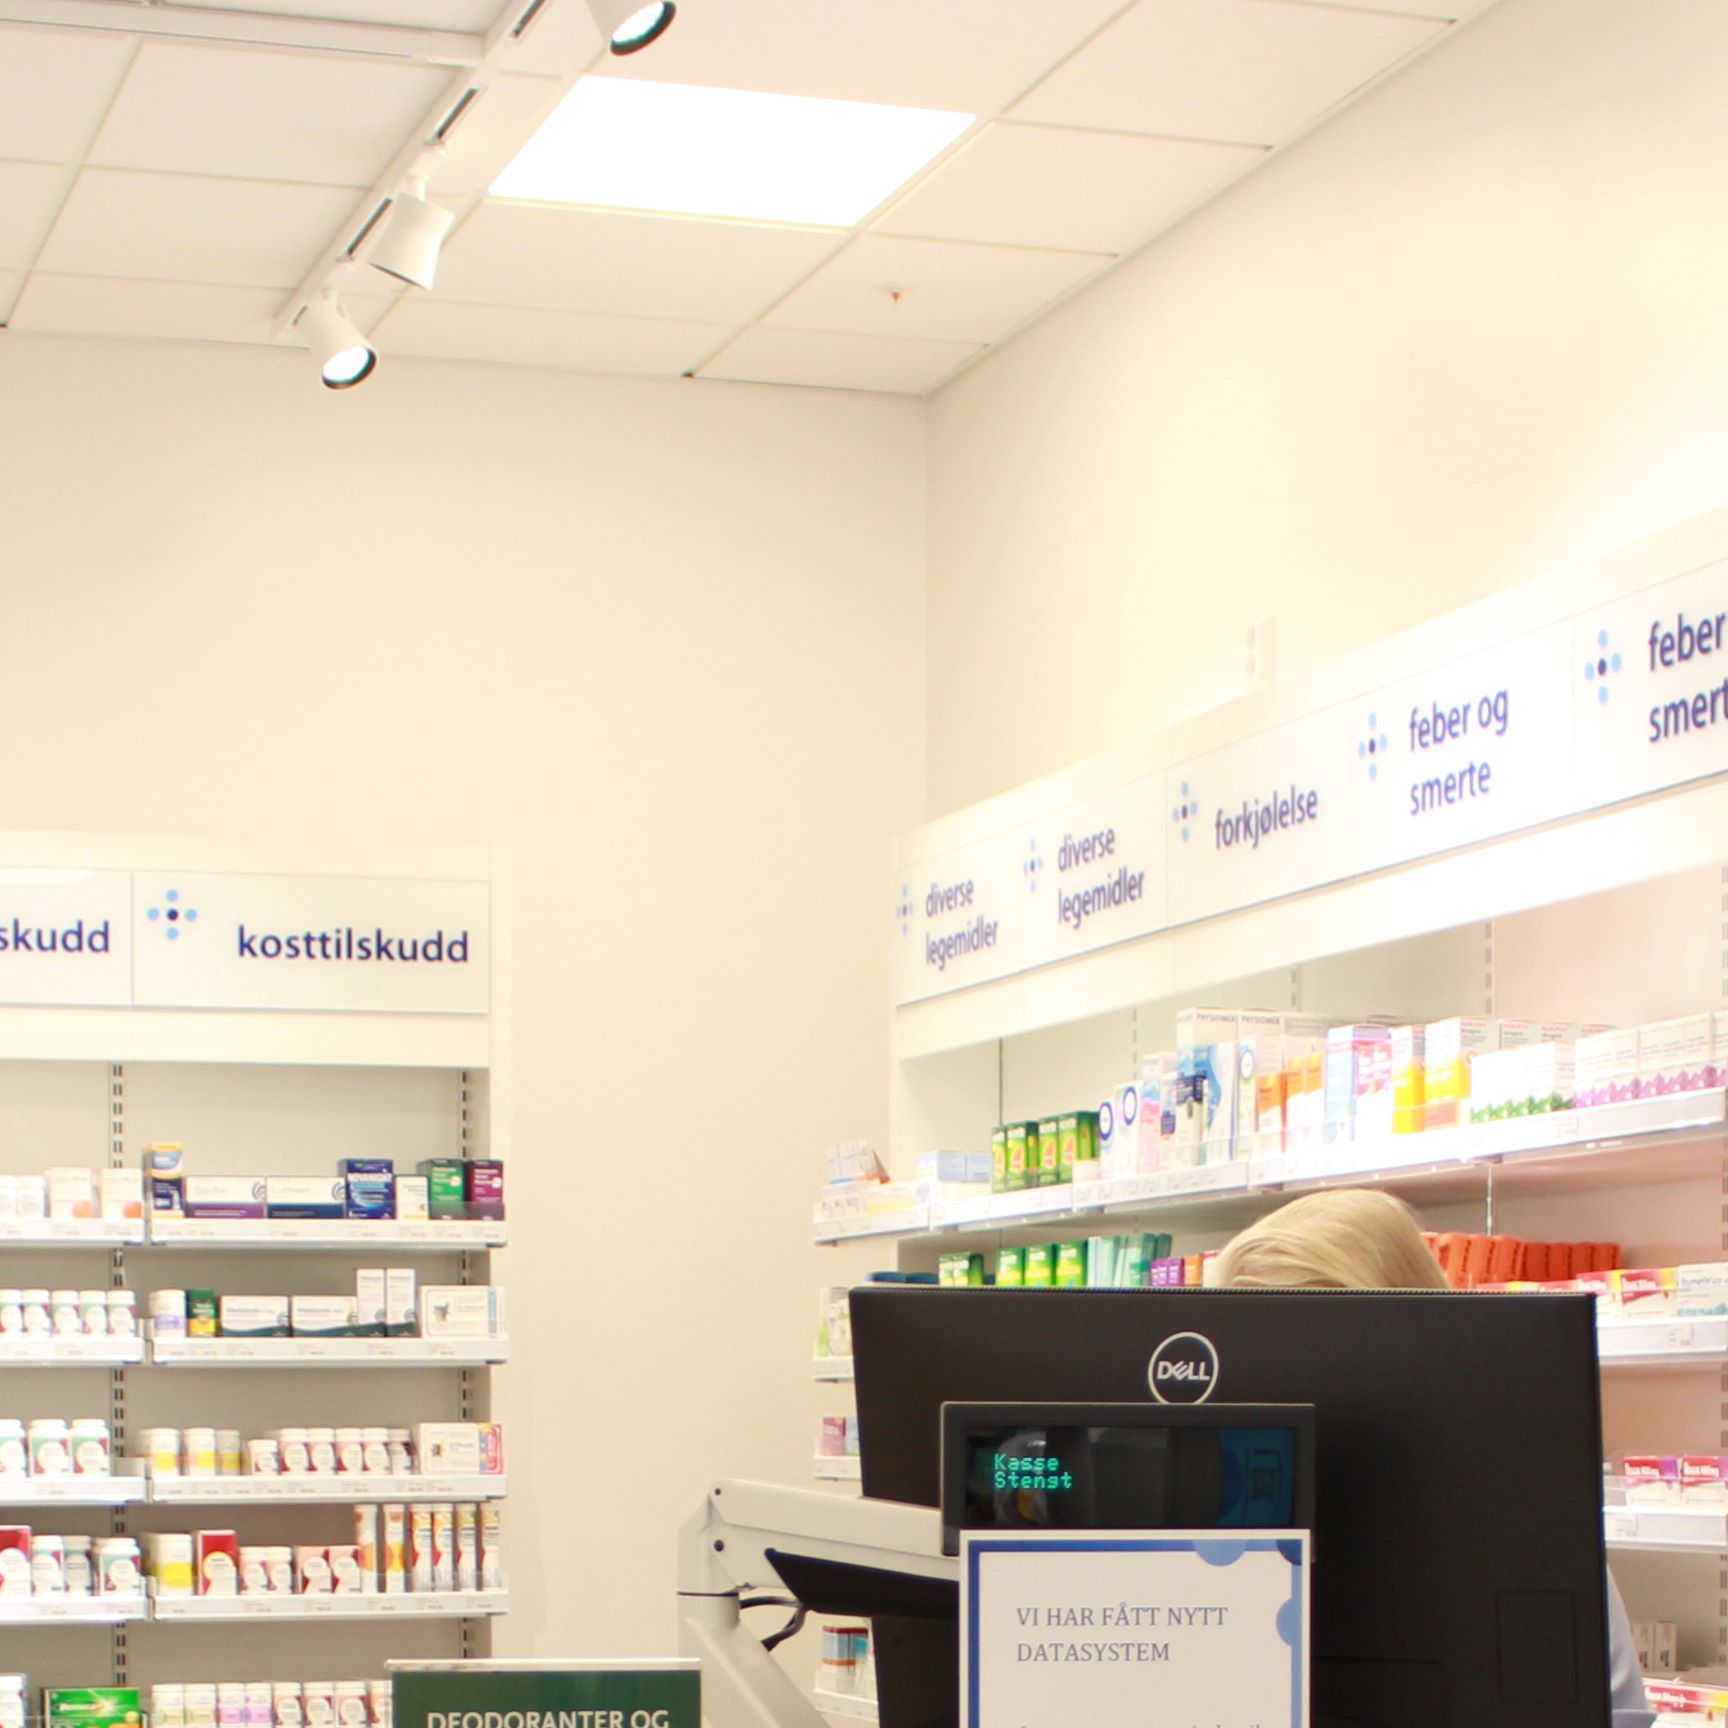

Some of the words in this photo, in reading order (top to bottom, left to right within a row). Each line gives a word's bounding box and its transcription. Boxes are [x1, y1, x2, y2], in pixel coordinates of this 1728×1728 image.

[1648, 606, 1728, 671] feber
[1409, 695, 1471, 753] feber
[1477, 687, 1509, 737] og
[1409, 760, 1492, 816] smerte
[1214, 786, 1319, 855] forkjølelse
[1056, 824, 1116, 873] diverse
[924, 876, 975, 918] diverse
[1057, 868, 1145, 930] legemidler
[237, 924, 470, 964] kosttilskudd
[924, 916, 1000, 970] legemidler
[1156, 1360, 1210, 1381] DELL
[994, 1453, 1060, 1471] Kasse
[1016, 1607, 1039, 1626] VI
[1046, 1607, 1095, 1626] HAR
[1101, 1601, 1160, 1626] FÅTT
[1167, 1607, 1229, 1626] NYTT
[1016, 1643, 1171, 1662] DATASYSTEM
